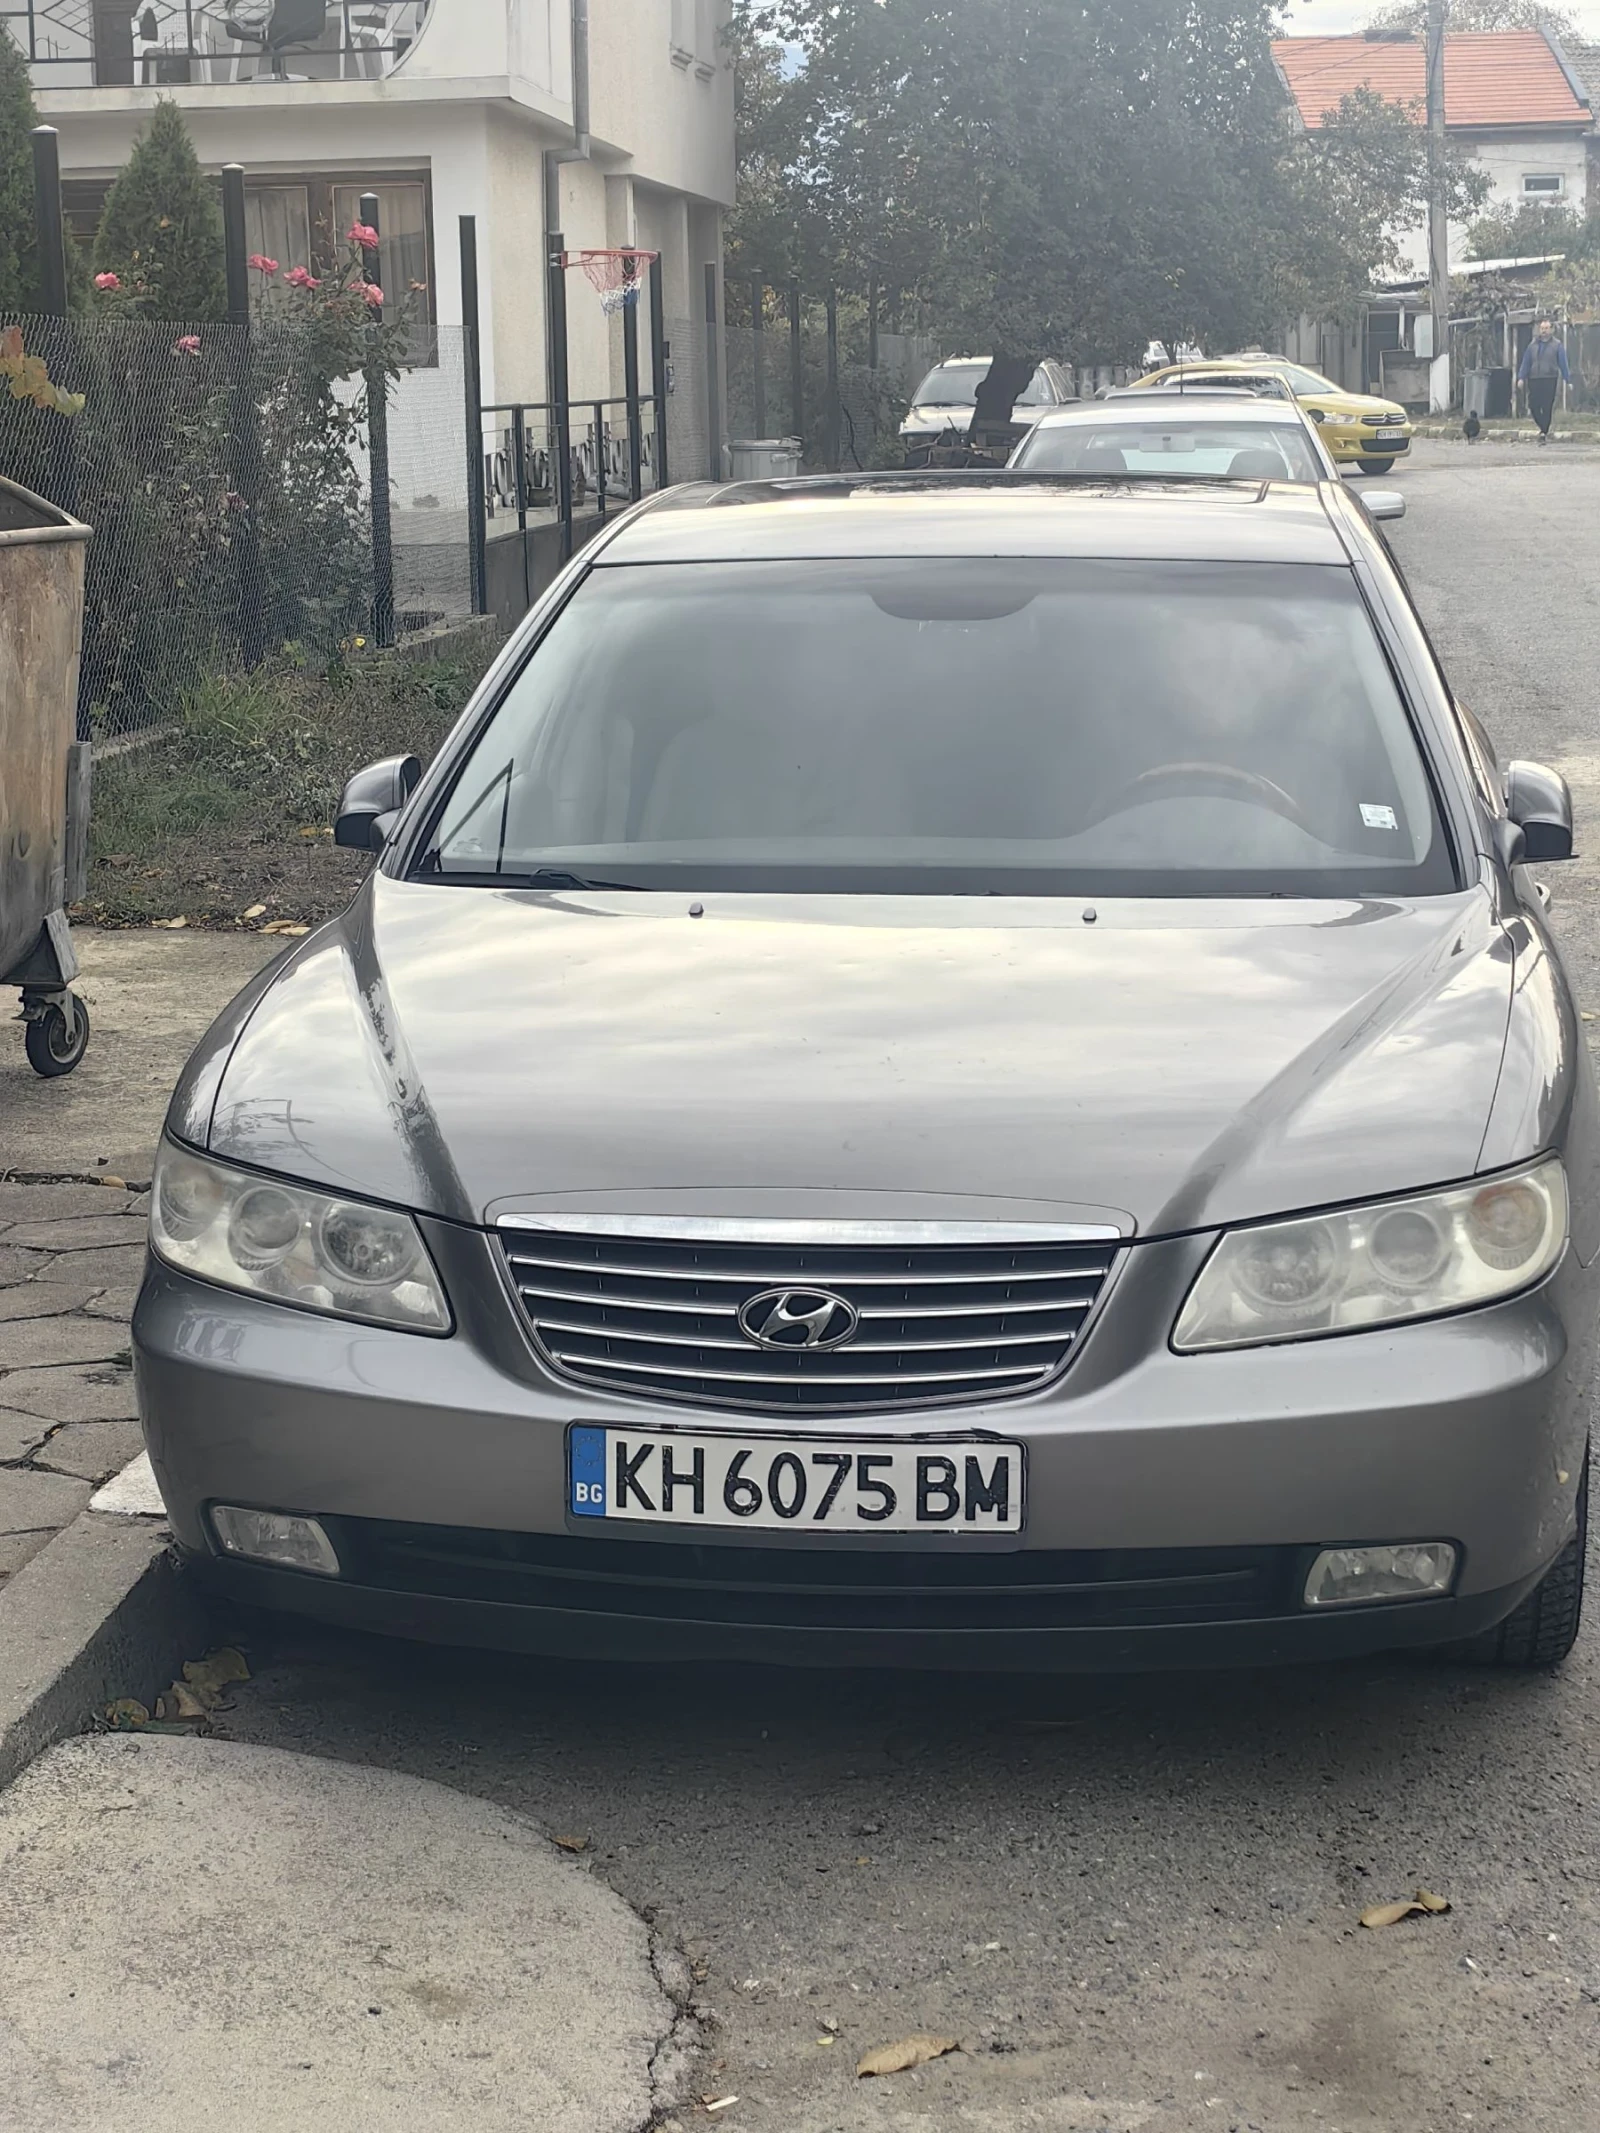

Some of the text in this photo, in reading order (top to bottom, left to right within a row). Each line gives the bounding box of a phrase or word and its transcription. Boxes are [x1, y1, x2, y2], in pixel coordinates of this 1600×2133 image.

[576, 1481, 603, 1503] BG
[615, 1441, 1009, 1522] KH 6075 BM
